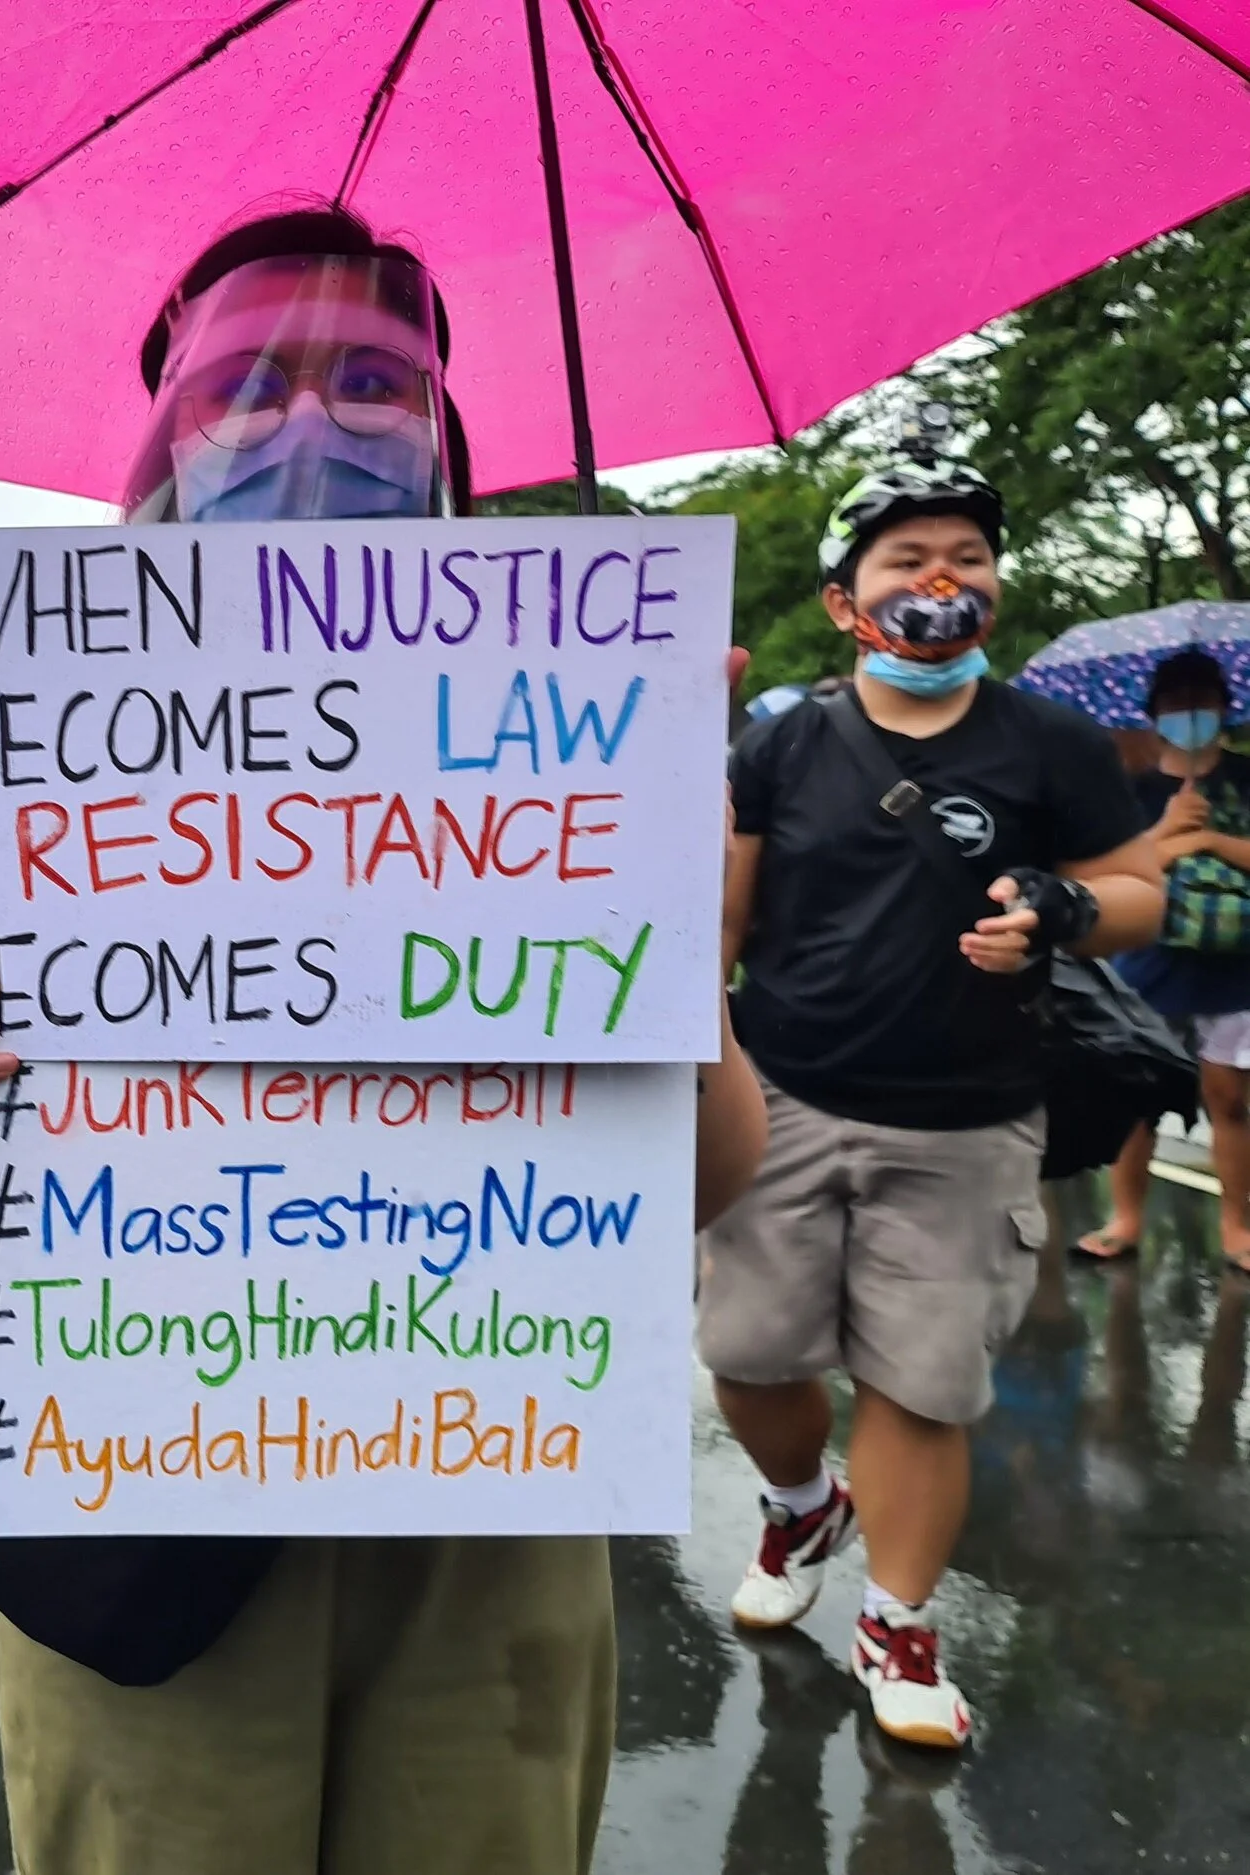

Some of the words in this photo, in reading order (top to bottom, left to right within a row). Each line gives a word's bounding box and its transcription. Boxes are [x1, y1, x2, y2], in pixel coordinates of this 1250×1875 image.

[257, 544, 680, 653] INJUSTICE
[436, 669, 646, 775] LAW
[15, 792, 623, 901] RESISTANCE
[400, 921, 654, 1037] DUTY
